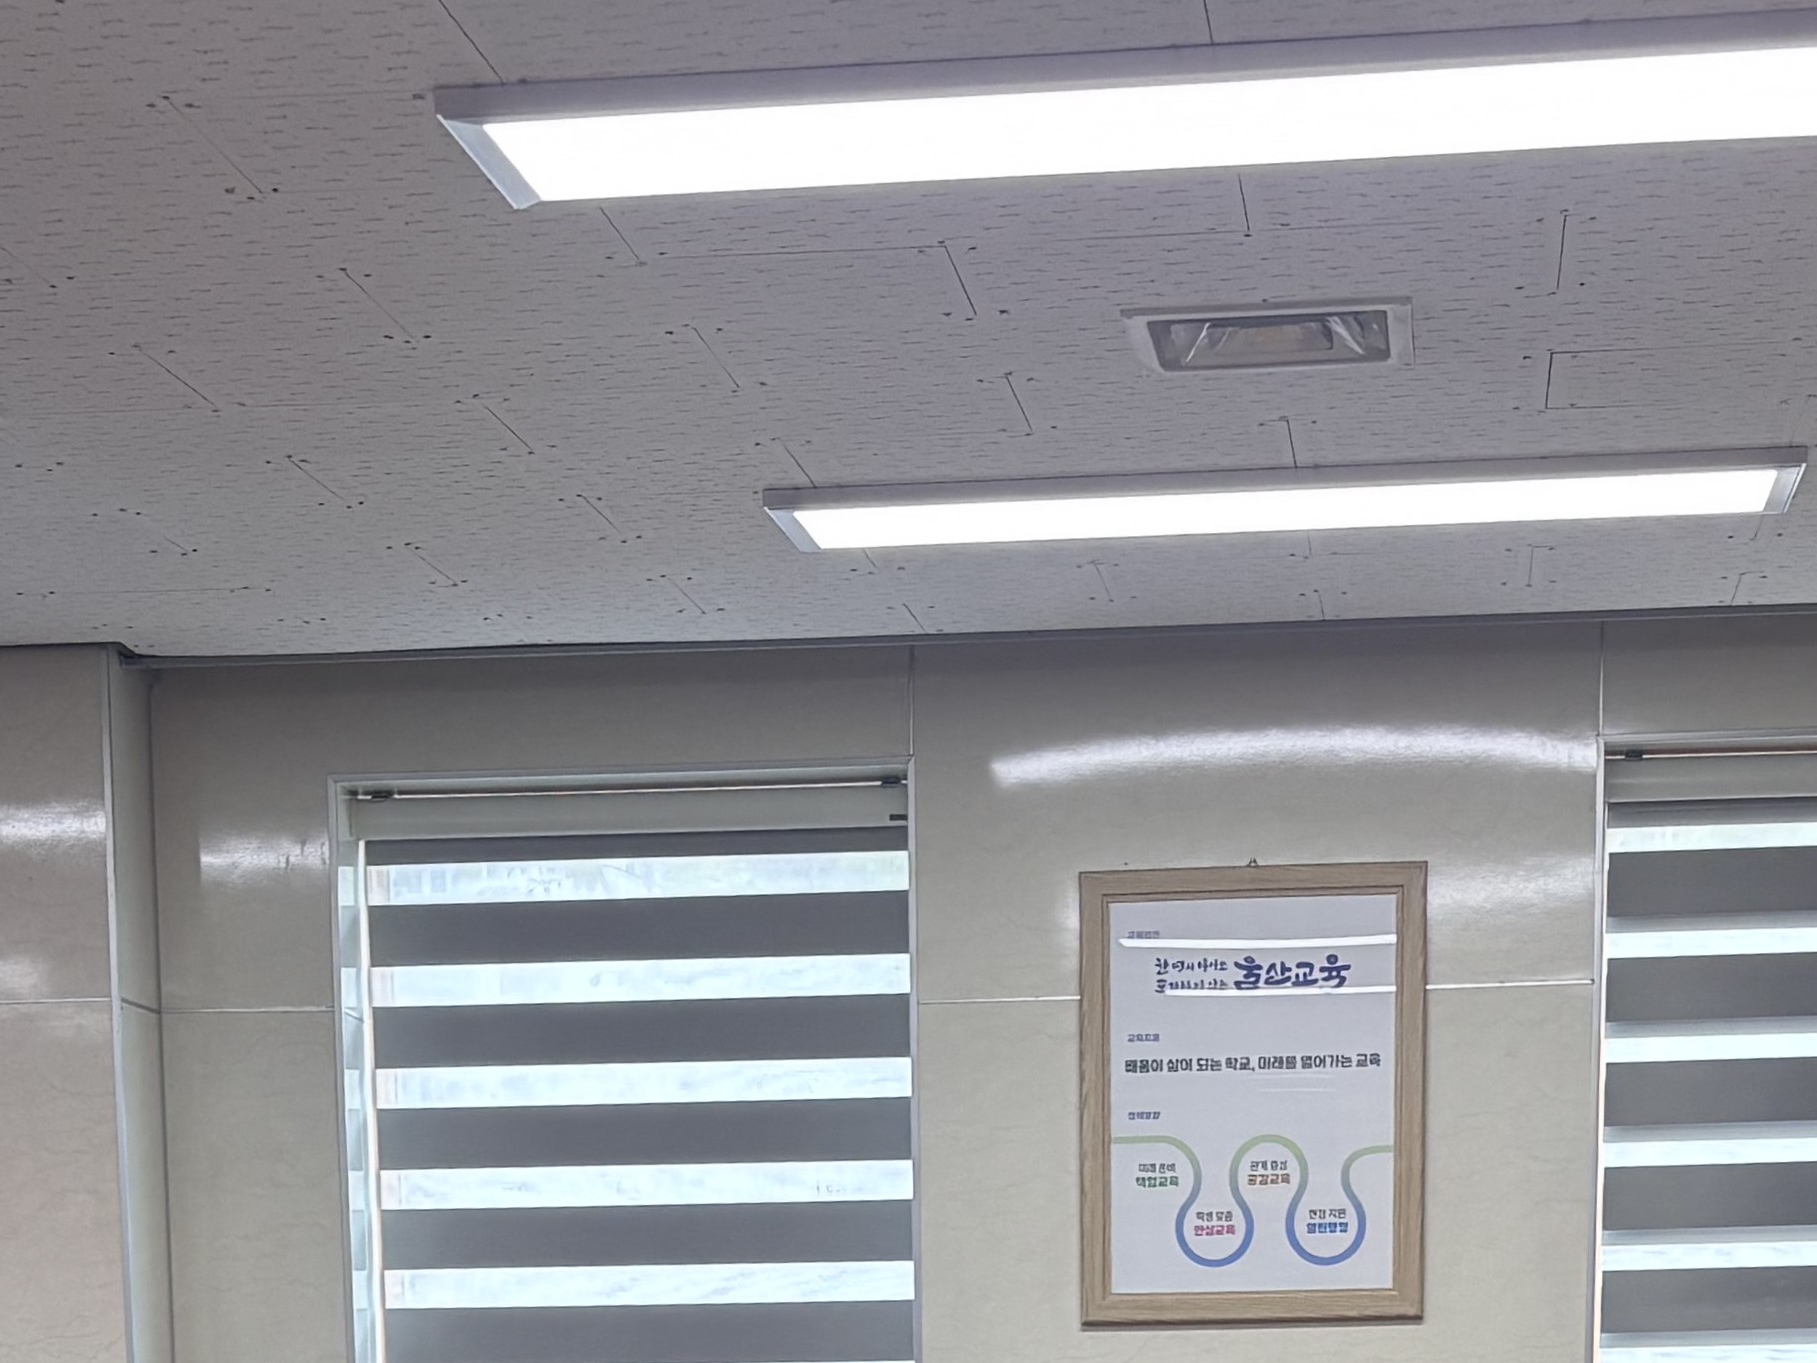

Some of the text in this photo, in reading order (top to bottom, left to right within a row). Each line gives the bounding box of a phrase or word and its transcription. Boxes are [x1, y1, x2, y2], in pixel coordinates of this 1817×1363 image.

[1233, 953, 1352, 990] 울산교육
[1196, 1057, 1222, 1072] 되는
[1355, 1053, 1382, 1068] 교육
